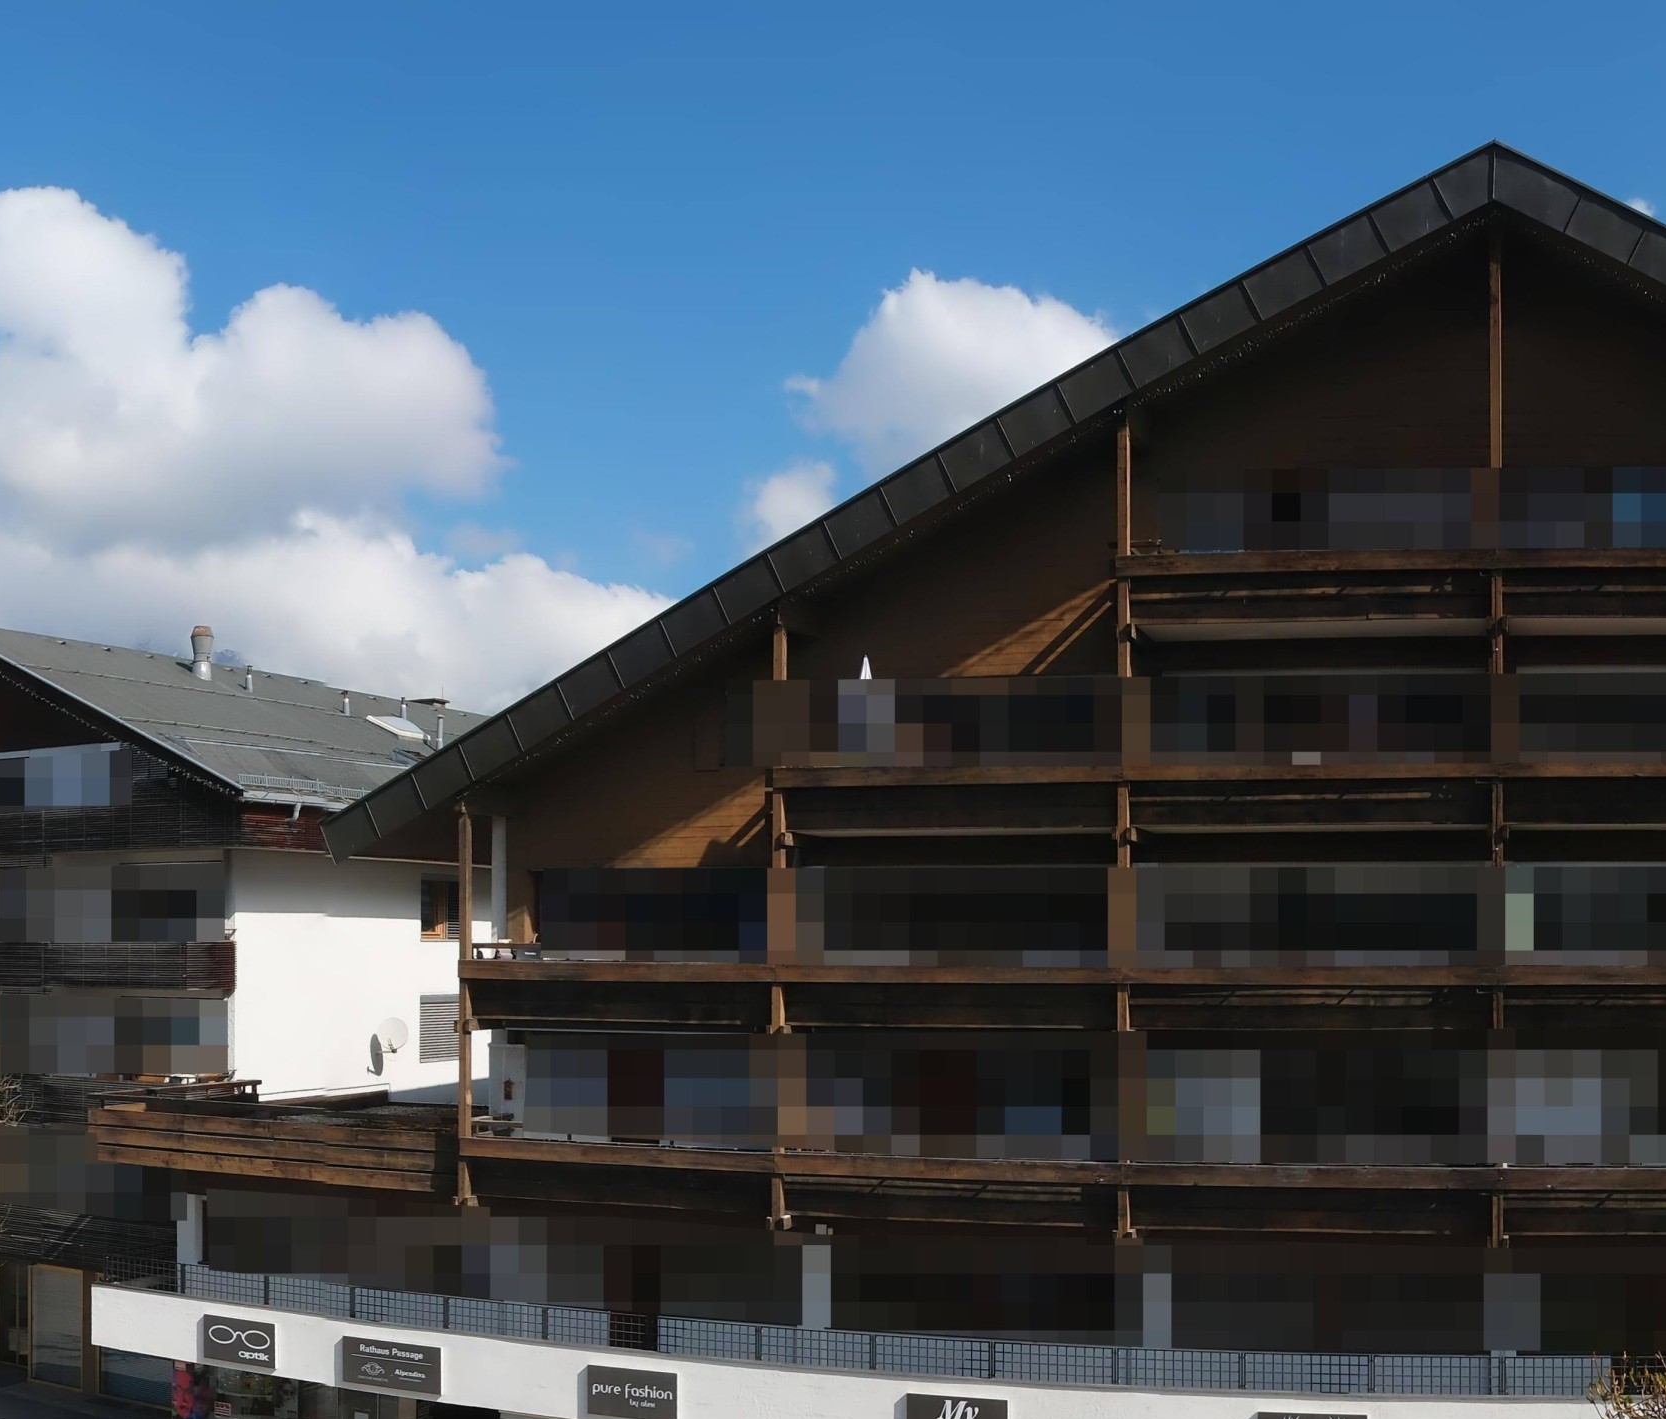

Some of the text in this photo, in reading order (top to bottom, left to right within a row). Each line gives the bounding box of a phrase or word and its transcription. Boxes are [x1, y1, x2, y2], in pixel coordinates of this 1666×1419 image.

[238, 1350, 270, 1362] optik
[359, 1343, 424, 1360] Rathaus Passage
[592, 1383, 673, 1400] pure fashion
